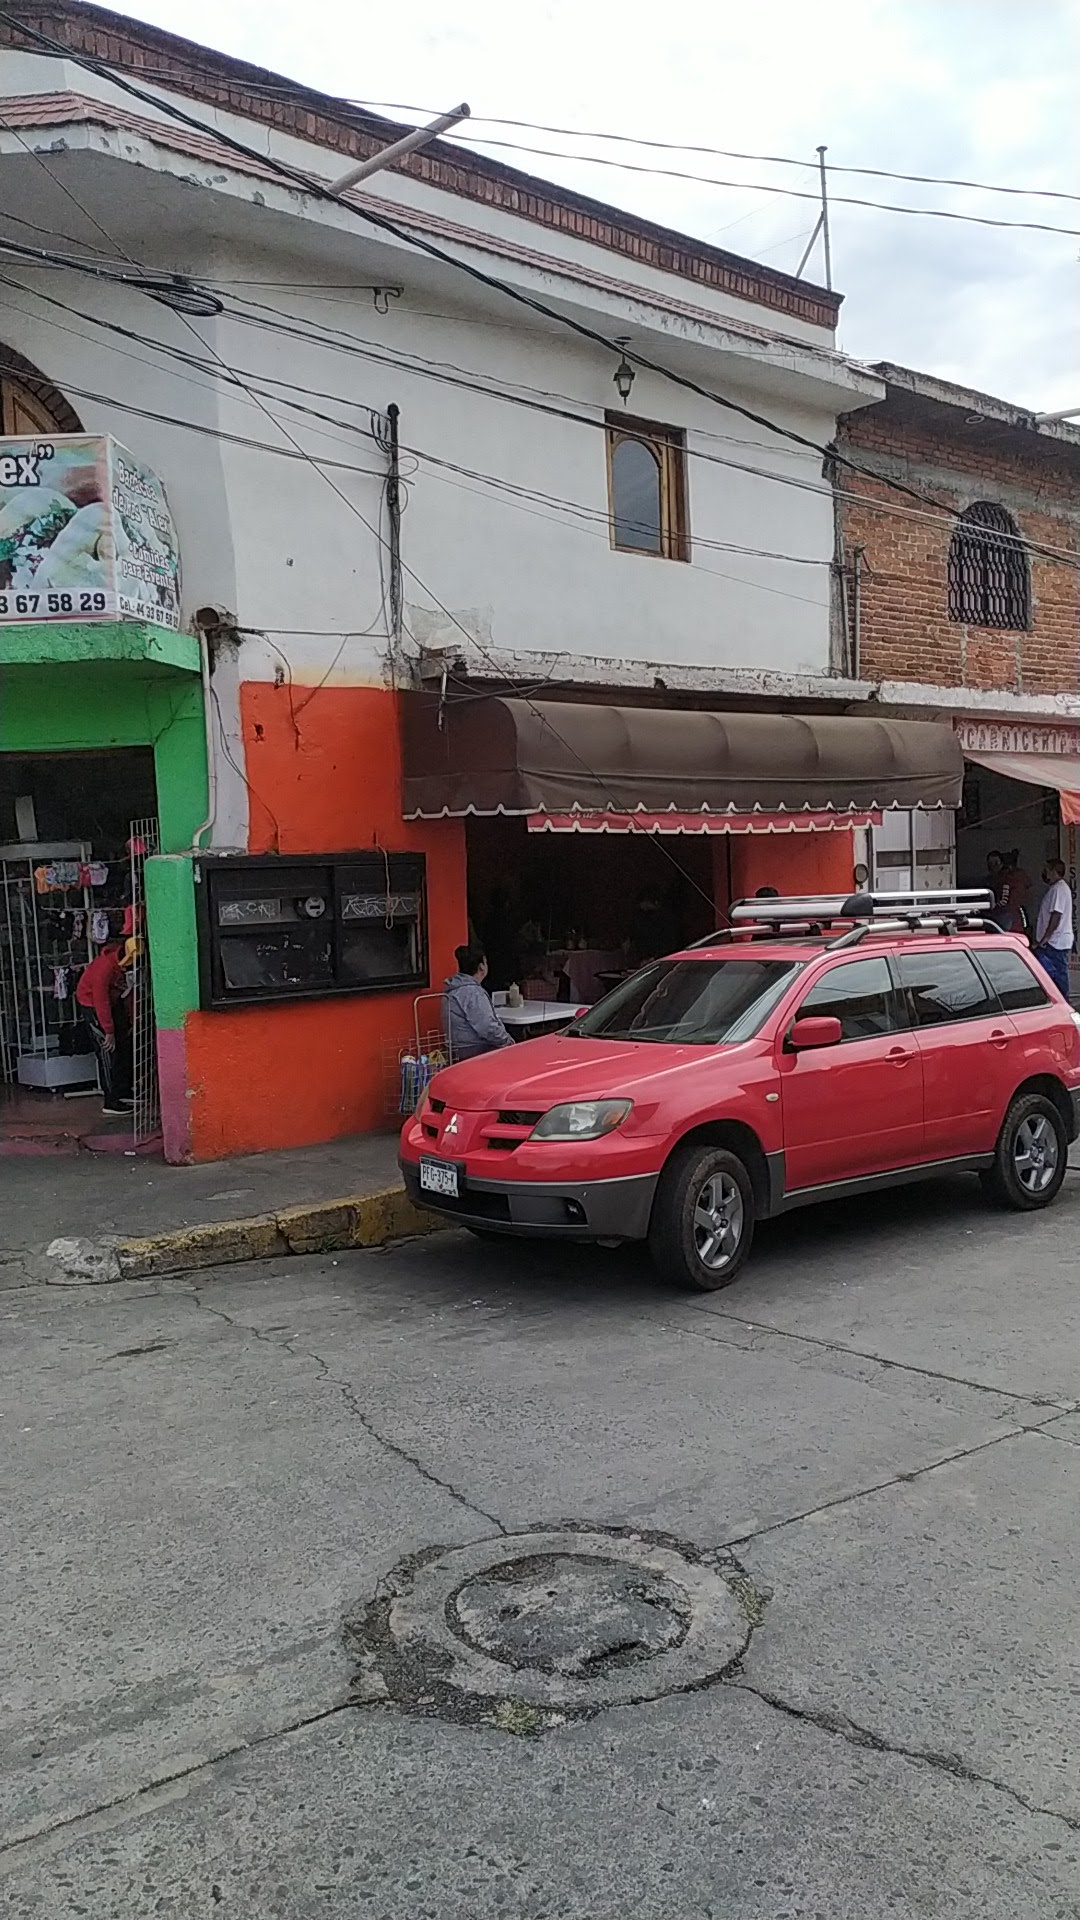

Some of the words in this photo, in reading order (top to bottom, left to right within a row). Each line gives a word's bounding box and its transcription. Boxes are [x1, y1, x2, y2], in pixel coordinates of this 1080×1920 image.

[121, 558, 143, 580] para
[142, 563, 176, 592] Eventos
[16, 594, 40, 614] 67
[47, 593, 73, 612] 58
[80, 592, 106, 612] 29
[136, 602, 145, 617] 44
[146, 605, 155, 620] 33
[155, 609, 165, 623] 67
